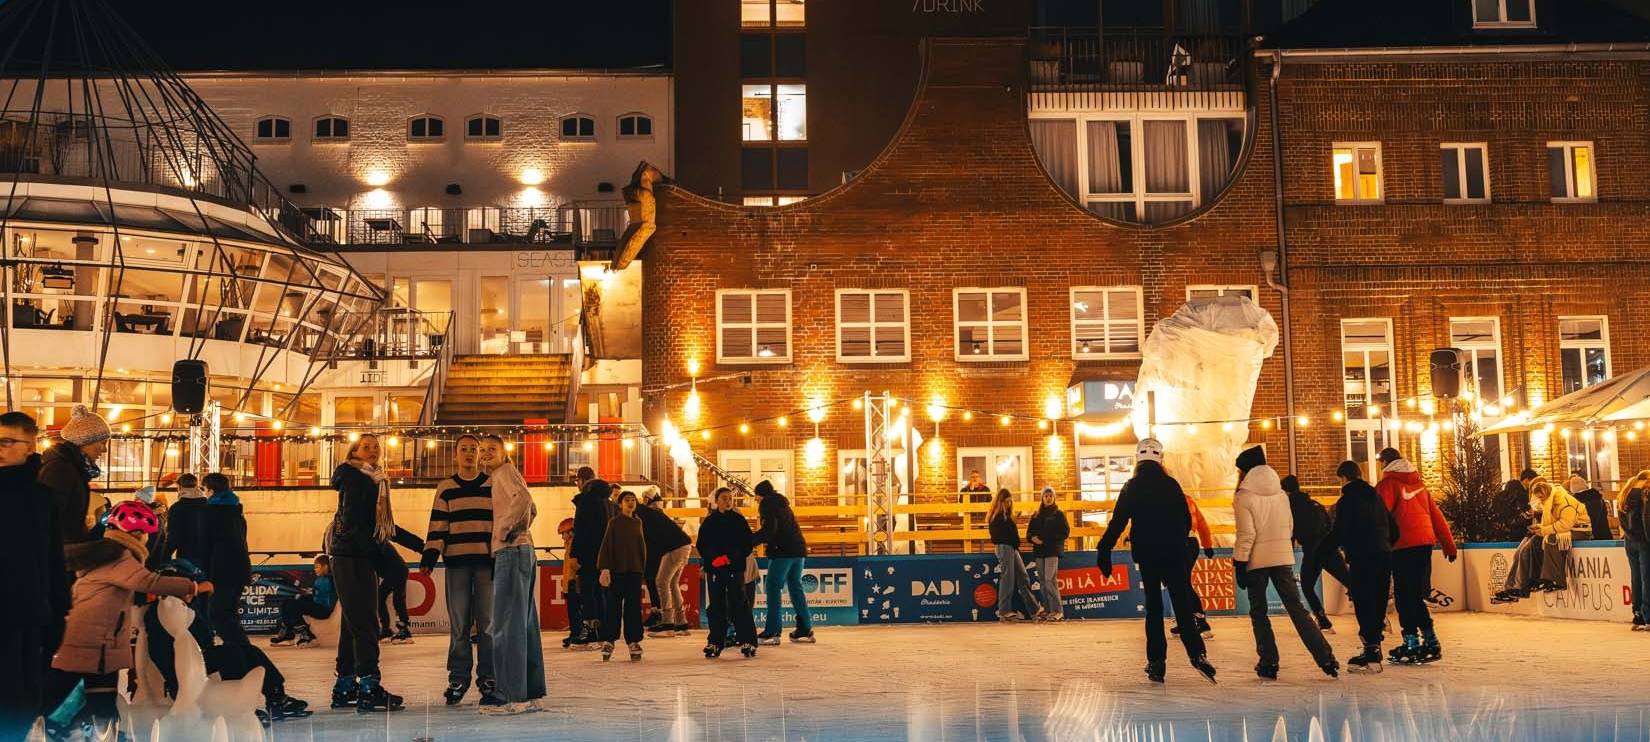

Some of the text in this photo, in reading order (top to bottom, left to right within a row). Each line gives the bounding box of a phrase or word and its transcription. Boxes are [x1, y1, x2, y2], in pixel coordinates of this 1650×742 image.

[1194, 559, 1234, 571] APAS
[1056, 577, 1073, 591] OH
[1078, 573, 1096, 589] LÀ
[1192, 571, 1234, 584] APAS
[242, 585, 280, 596] OLIDAY
[911, 579, 960, 597] DADI
[1193, 584, 1234, 597] APAS
[246, 595, 266, 606] ICE
[1201, 597, 1235, 610] OVE
[1543, 583, 1613, 611] CAMPUS
[247, 607, 280, 616] LIMITS
